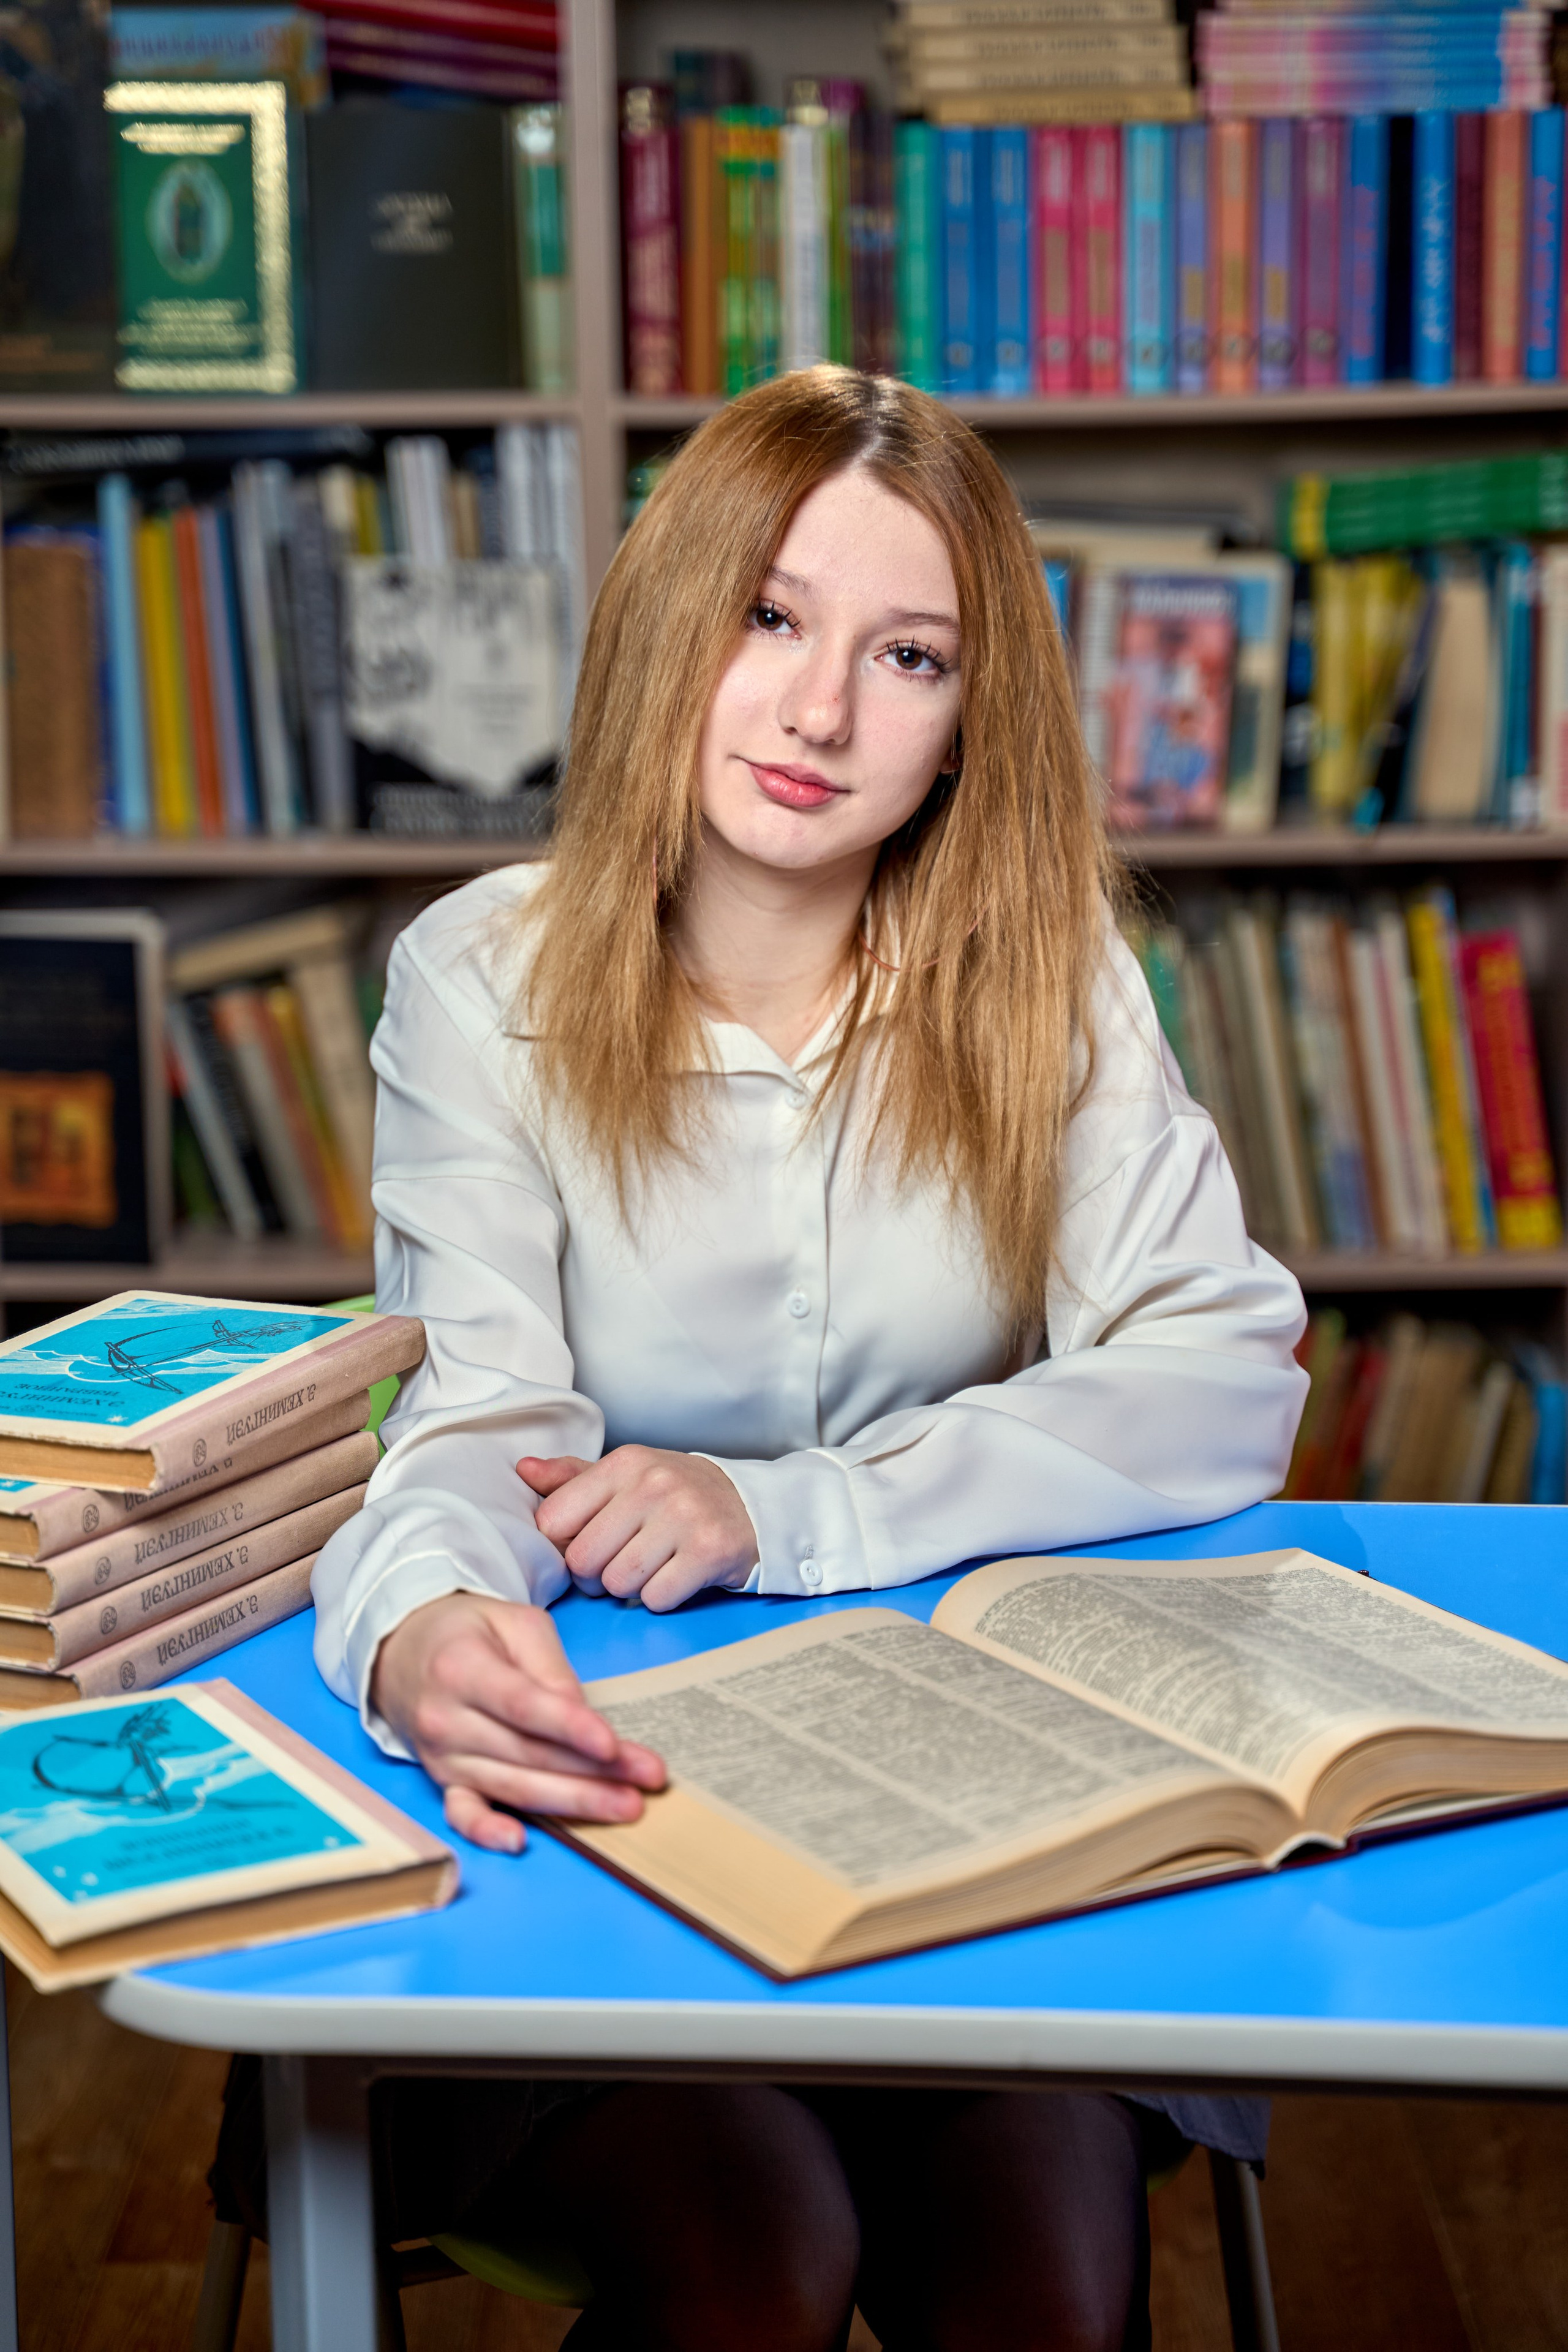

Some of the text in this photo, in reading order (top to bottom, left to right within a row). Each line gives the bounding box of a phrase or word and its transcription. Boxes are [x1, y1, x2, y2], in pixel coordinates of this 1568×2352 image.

[226, 1384, 317, 1446] Э. ХЕМИНГУЭЙ
[134, 1502, 243, 1565] Э. ХЕМИНГУЭЙ
[141, 1545, 249, 1613] Э. ХЕМИНГУЭЙ
[157, 1595, 258, 1666] Э. ХЕМИНГУЭЙ
